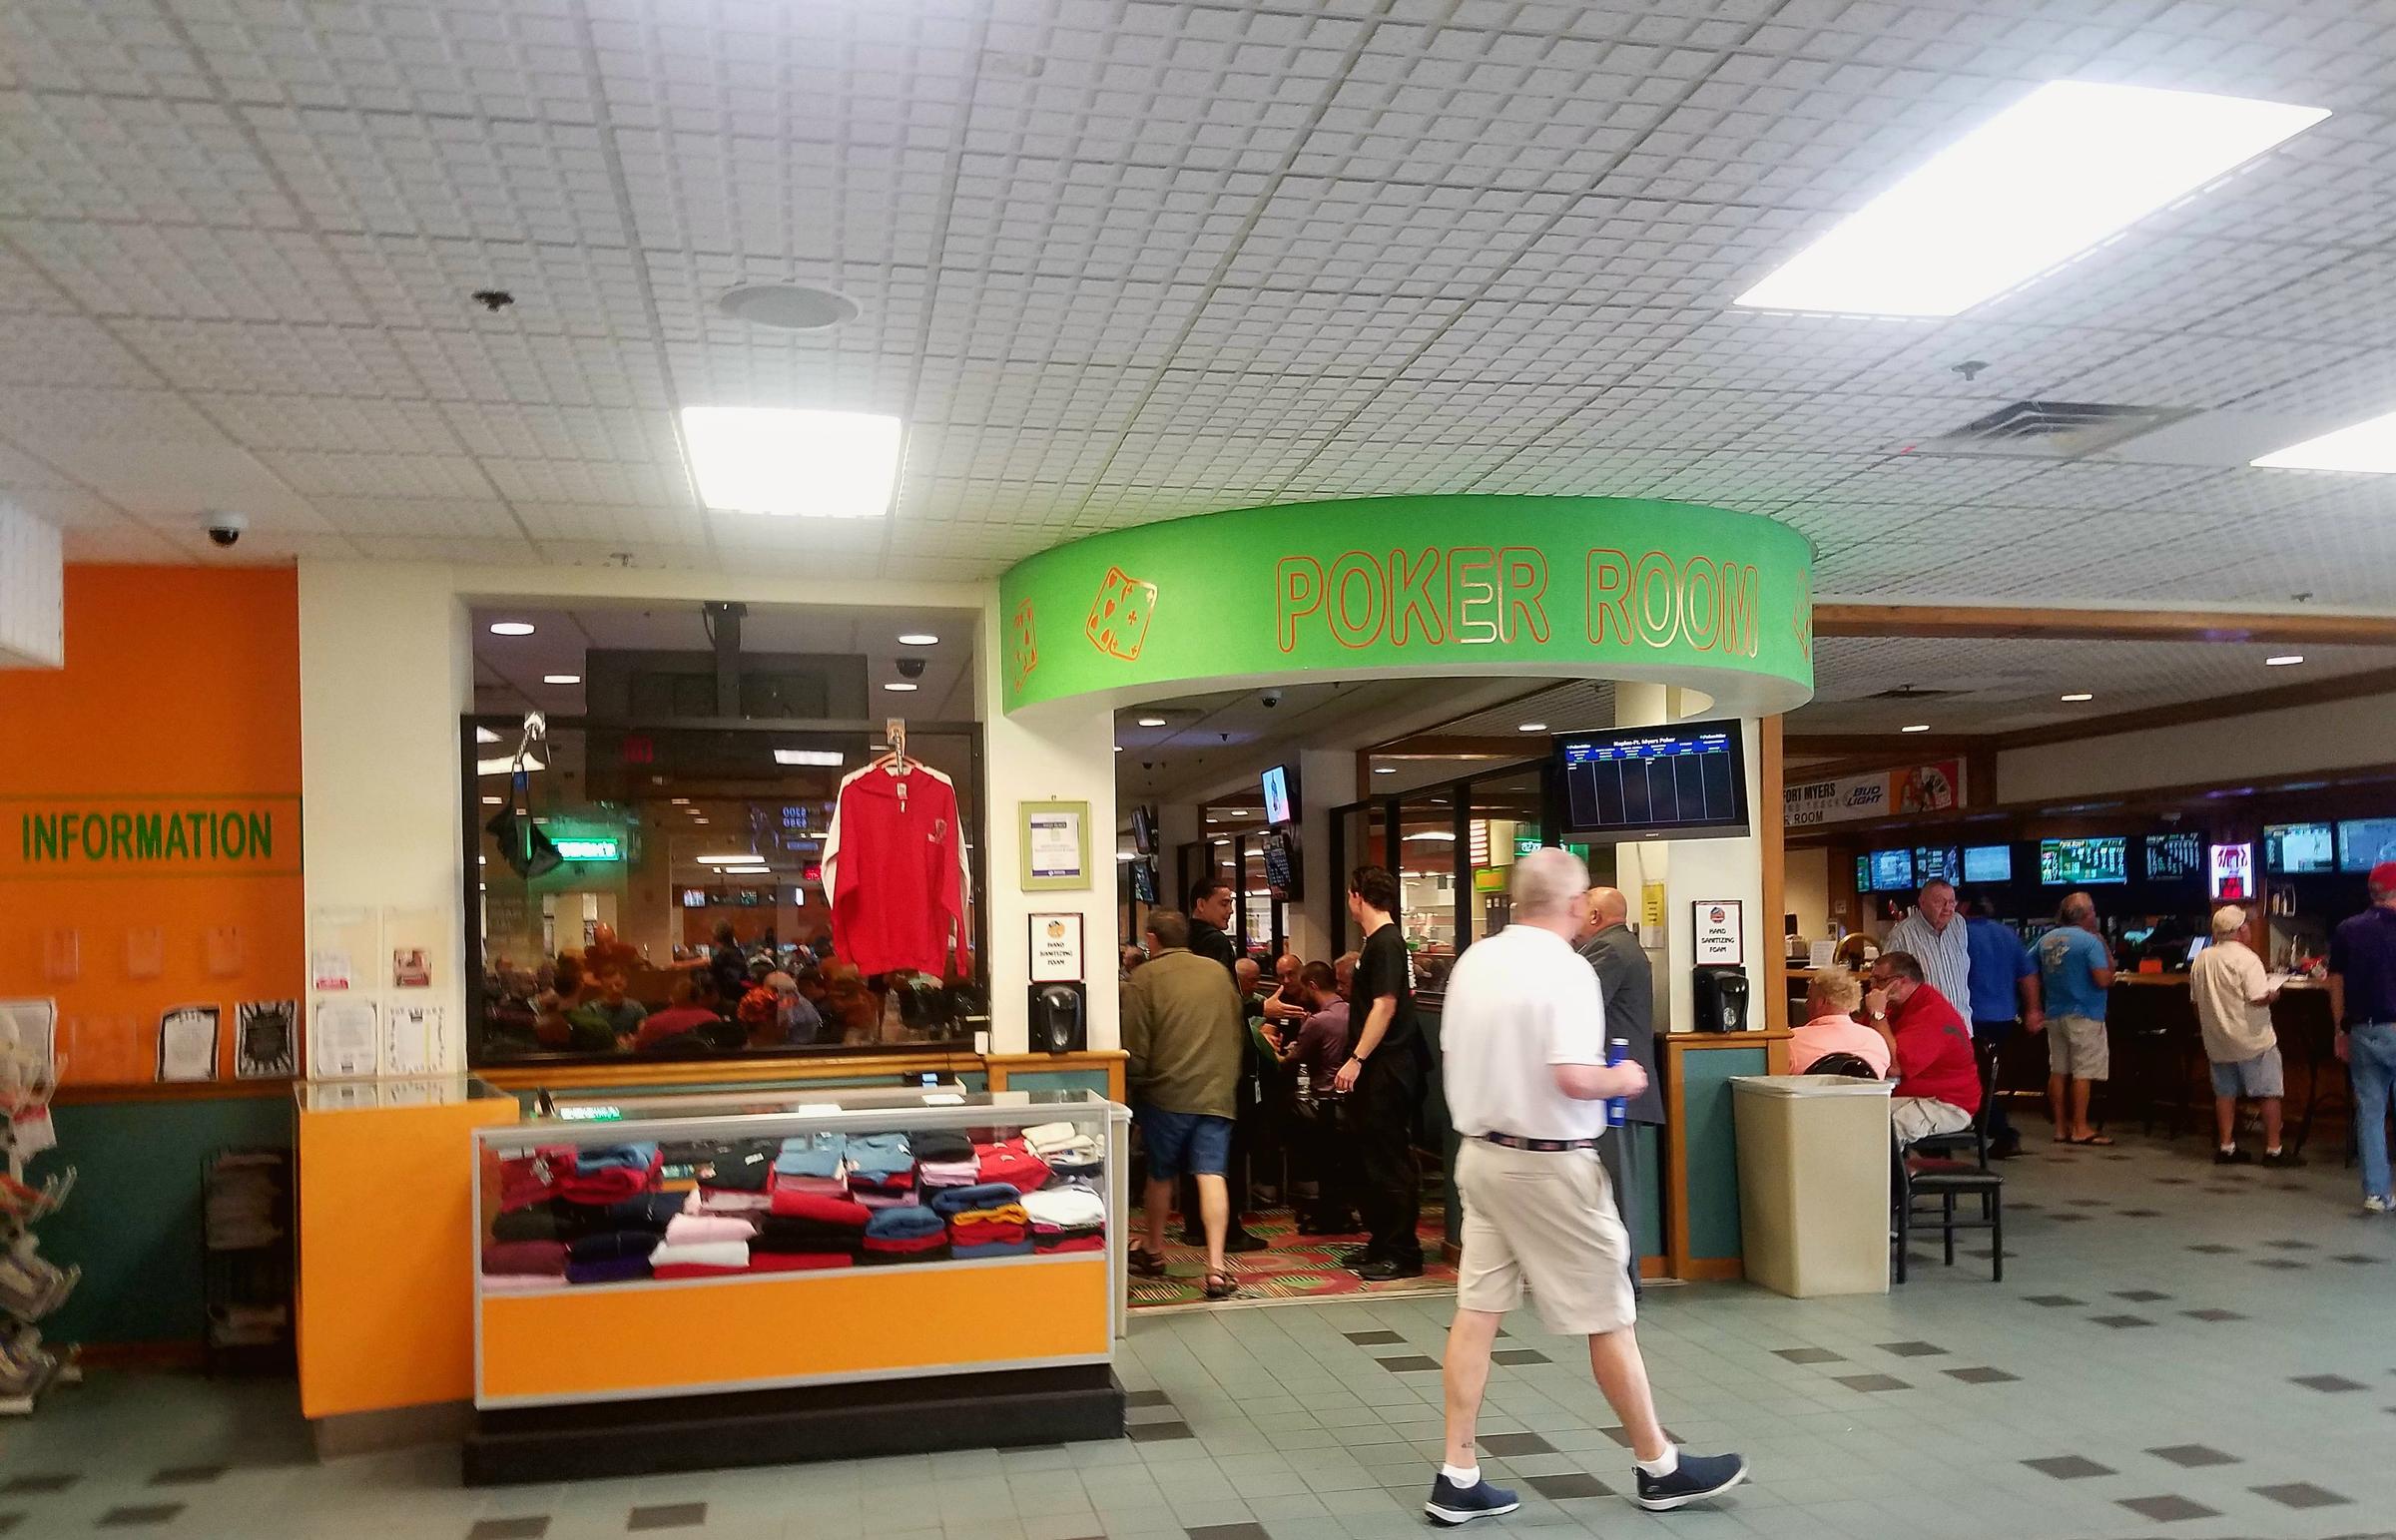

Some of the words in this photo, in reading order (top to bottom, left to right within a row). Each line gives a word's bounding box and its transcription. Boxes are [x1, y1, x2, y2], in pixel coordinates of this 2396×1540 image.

[1276, 546, 1550, 654] POKER
[1586, 548, 1759, 659] ROOM
[1804, 782, 1836, 799] MYERS
[1853, 785, 1881, 797] BUD
[1848, 793, 1883, 806] LIGHT
[1794, 810, 1823, 825] ROOM
[22, 809, 273, 861] INFORMATION
